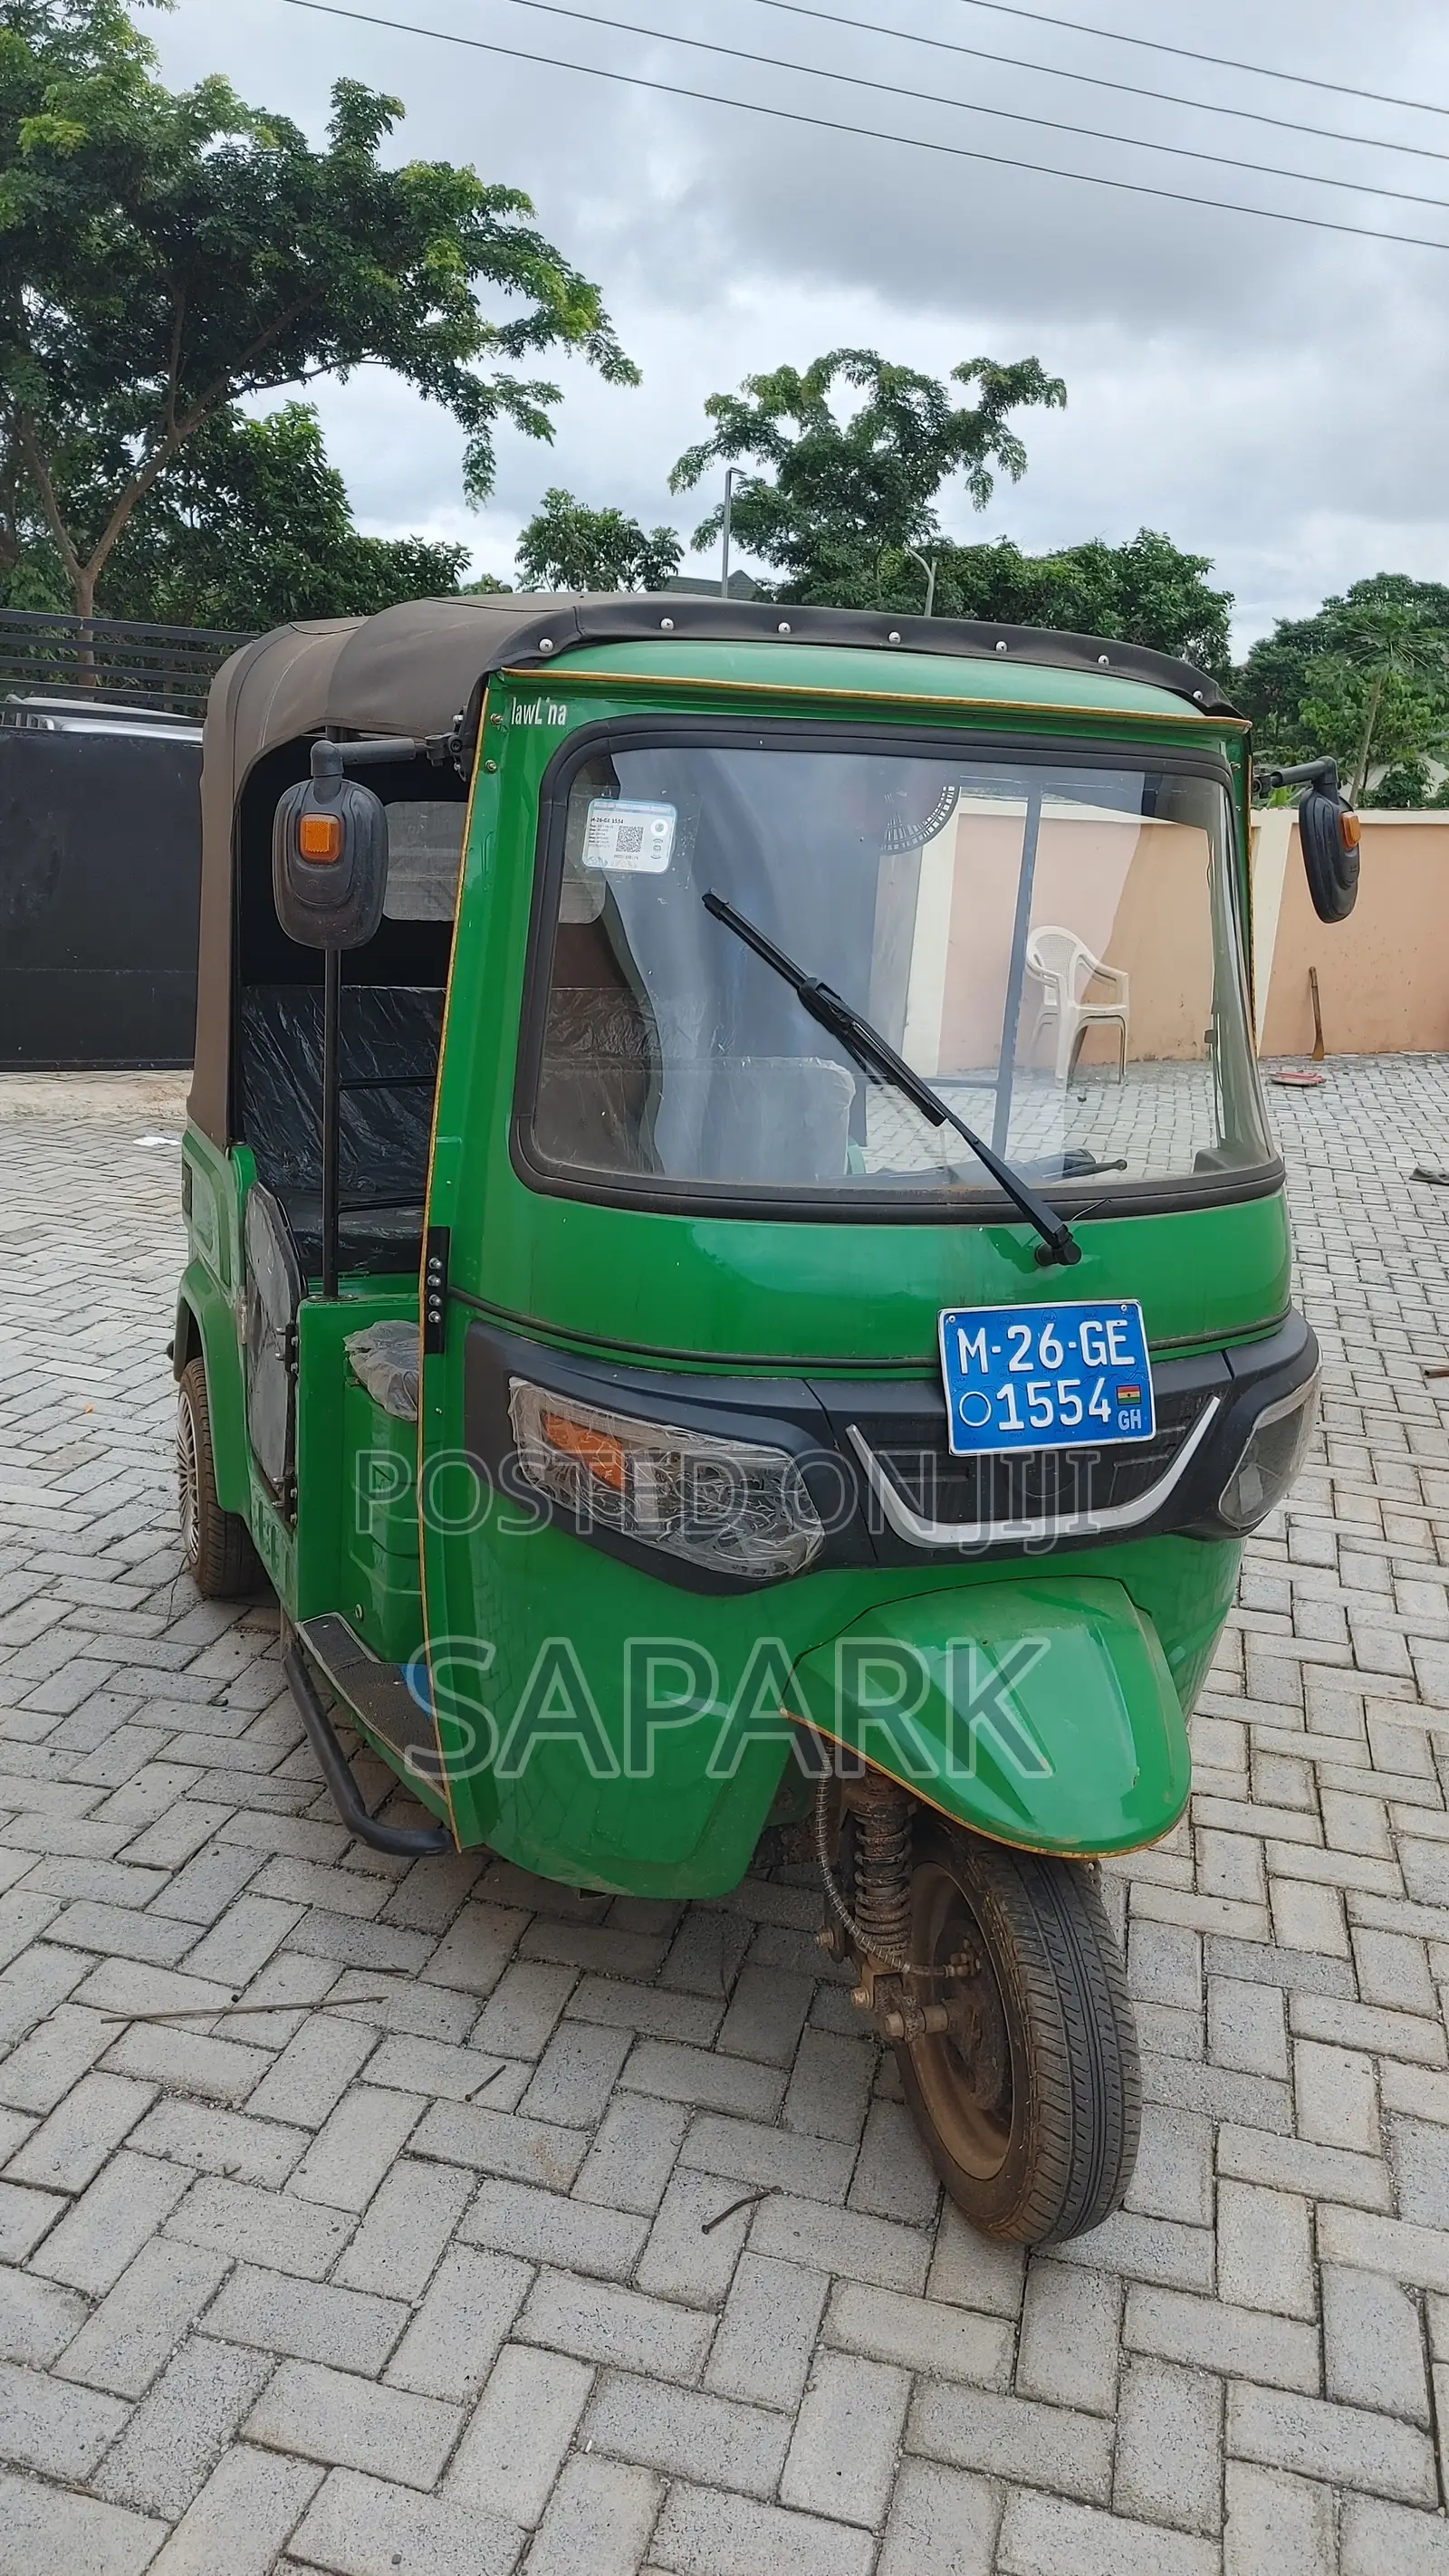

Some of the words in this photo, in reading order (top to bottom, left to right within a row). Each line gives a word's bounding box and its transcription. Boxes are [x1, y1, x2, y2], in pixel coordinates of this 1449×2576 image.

[957, 1319, 1136, 1374] M-26-GE
[996, 1377, 1112, 1431] 1554
[1118, 1409, 1142, 1431] GH
